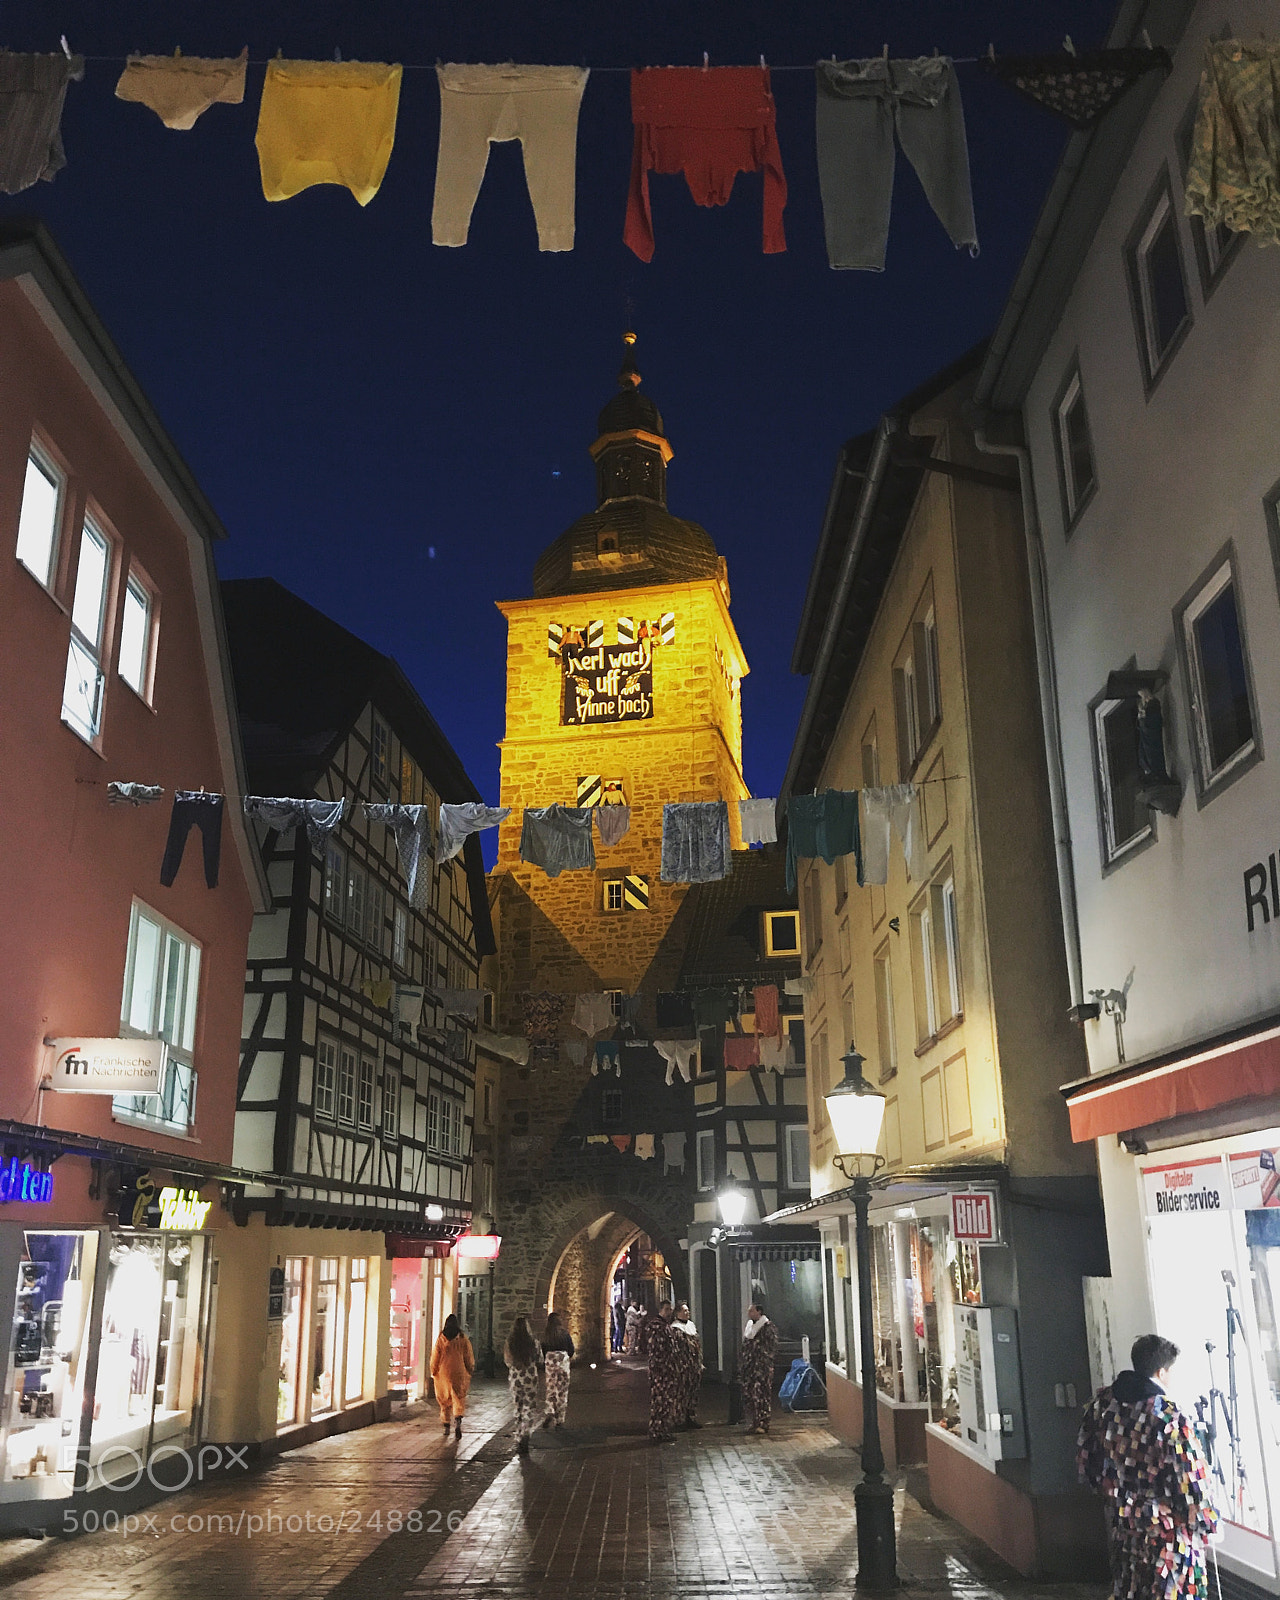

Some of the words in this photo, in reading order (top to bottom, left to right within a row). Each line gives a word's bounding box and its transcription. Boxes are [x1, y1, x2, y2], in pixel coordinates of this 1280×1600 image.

[608, 643, 651, 670] wach
[1243, 848, 1280, 932] RI
[65, 1054, 88, 1075] fn
[92, 1067, 157, 1077] Nachrichten
[1164, 1168, 1194, 1191] Digitaler
[1156, 1186, 1220, 1213] Bilderservice
[955, 1199, 989, 1234] Bild
